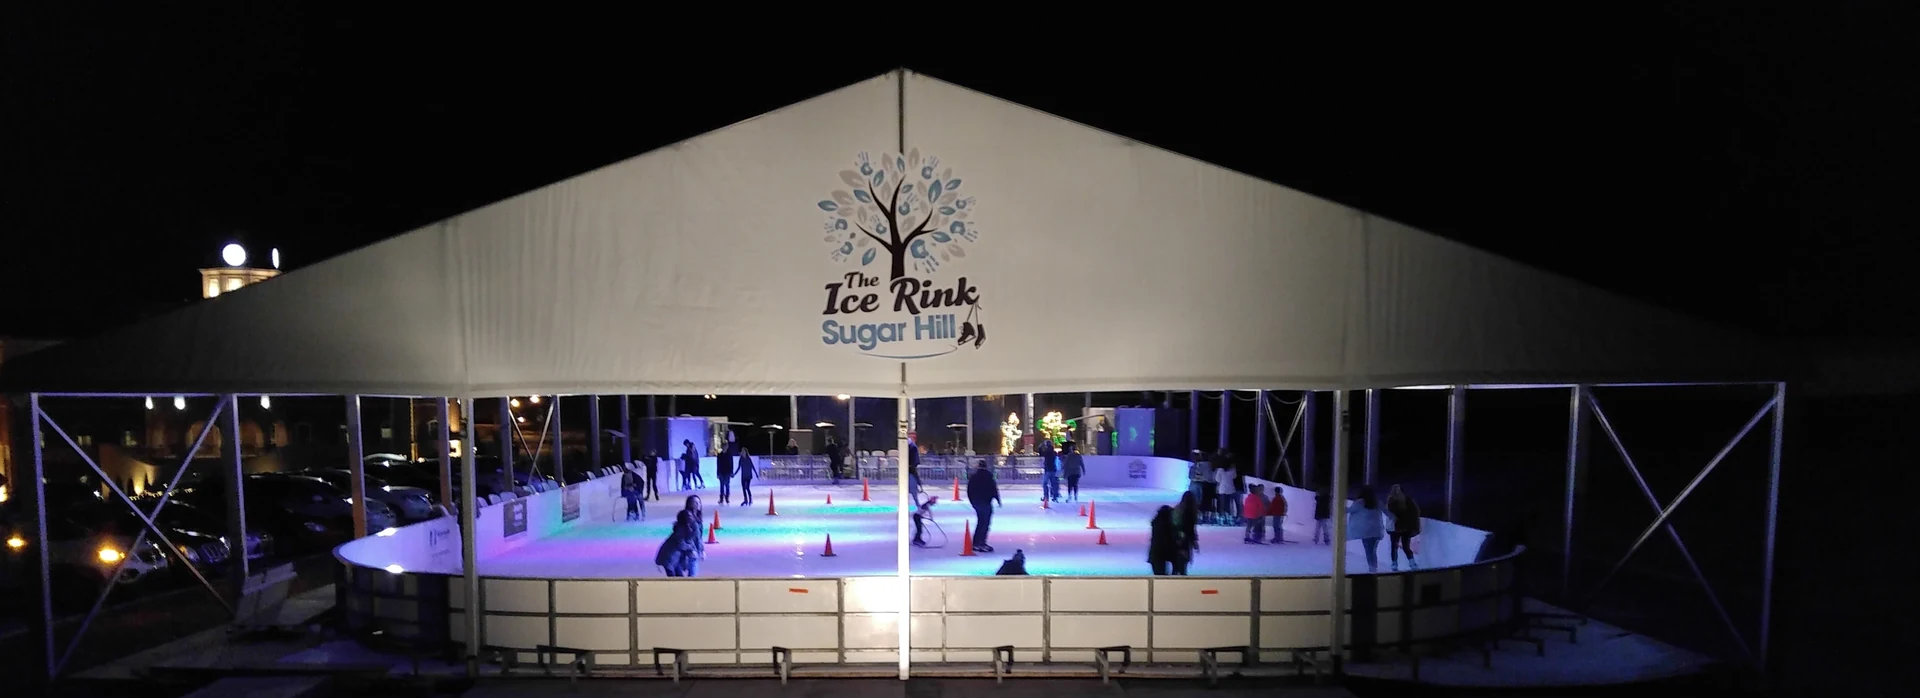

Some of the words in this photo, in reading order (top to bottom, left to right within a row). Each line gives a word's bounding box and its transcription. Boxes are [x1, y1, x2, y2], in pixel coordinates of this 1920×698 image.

[822, 282, 880, 315] Ice
[889, 276, 980, 315] Rink
[844, 271, 880, 289] The
[822, 319, 907, 351] Sugar
[914, 314, 956, 340] Hill
